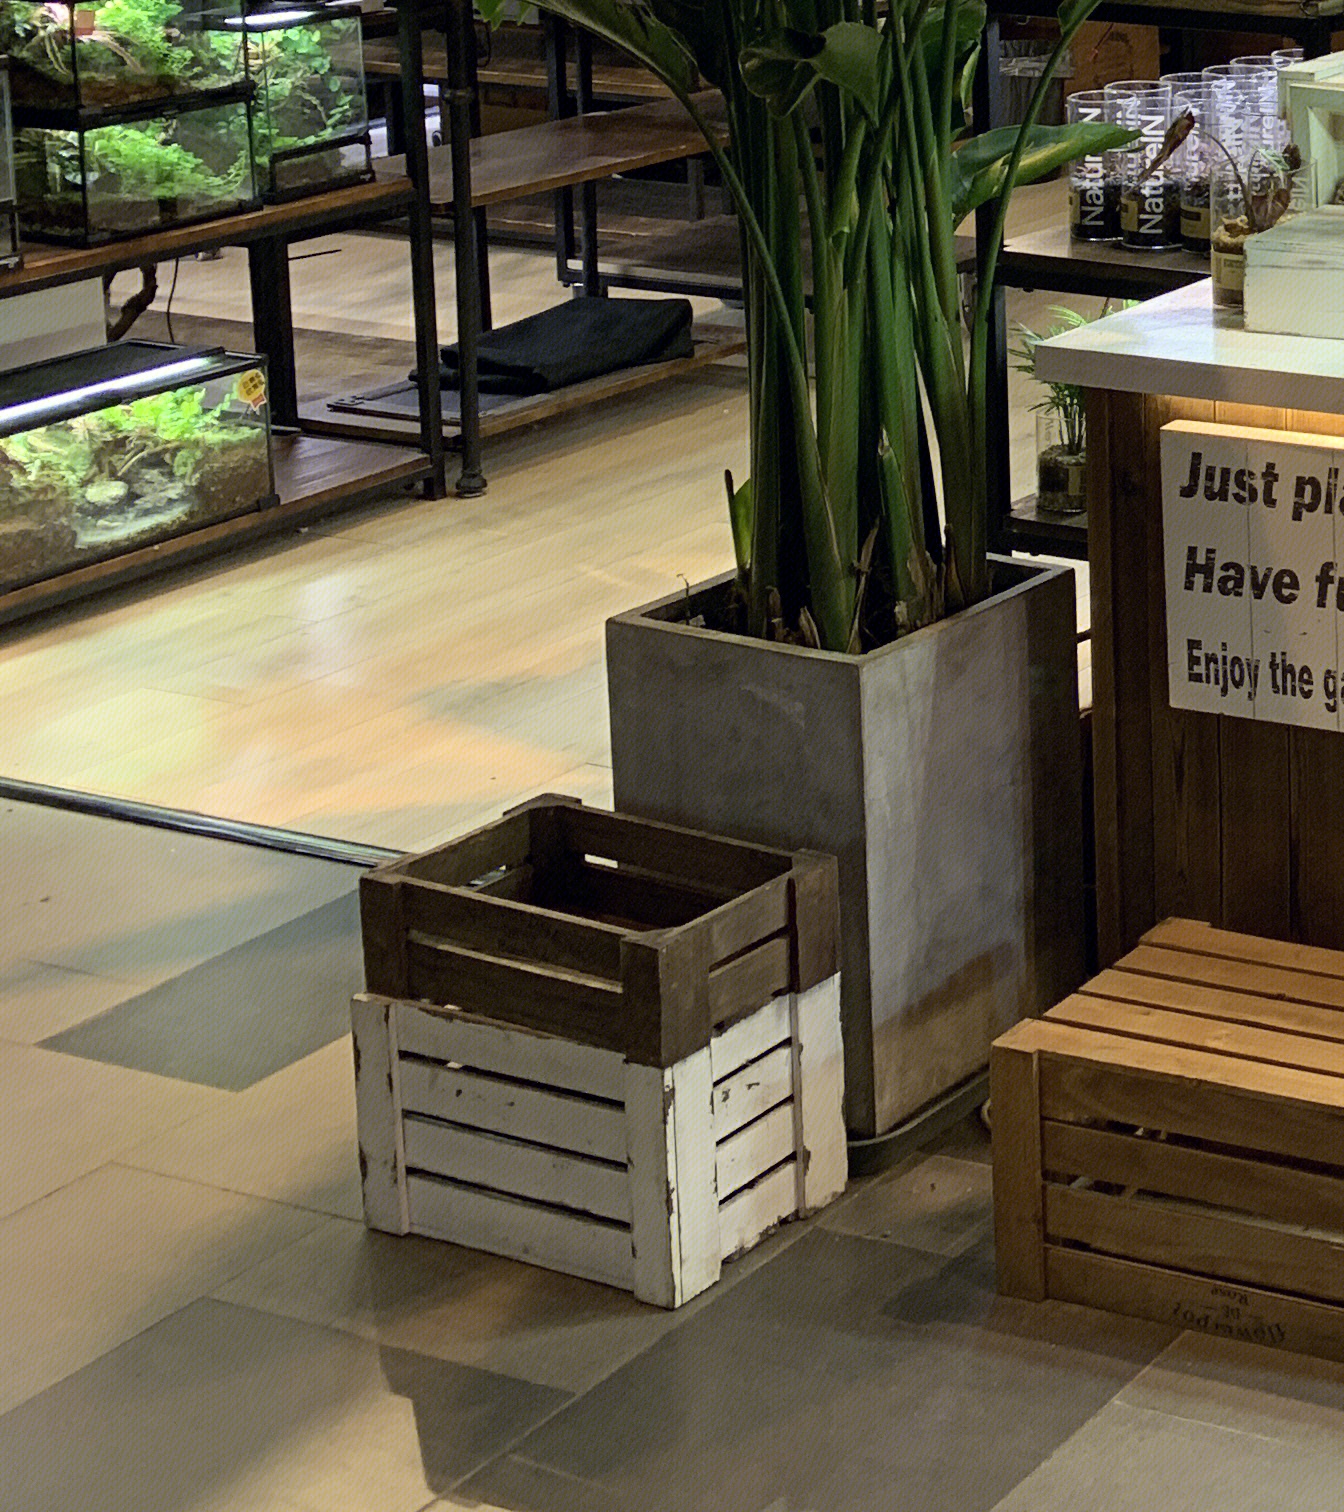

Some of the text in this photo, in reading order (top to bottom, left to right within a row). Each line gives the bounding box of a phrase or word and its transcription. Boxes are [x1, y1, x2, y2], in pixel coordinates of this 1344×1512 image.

[1078, 107, 1105, 226] NaturN
[1178, 452, 1279, 507] Just
[1182, 546, 1299, 605] Have
[1184, 639, 1261, 698] Enjoy
[1269, 646, 1313, 695] the
